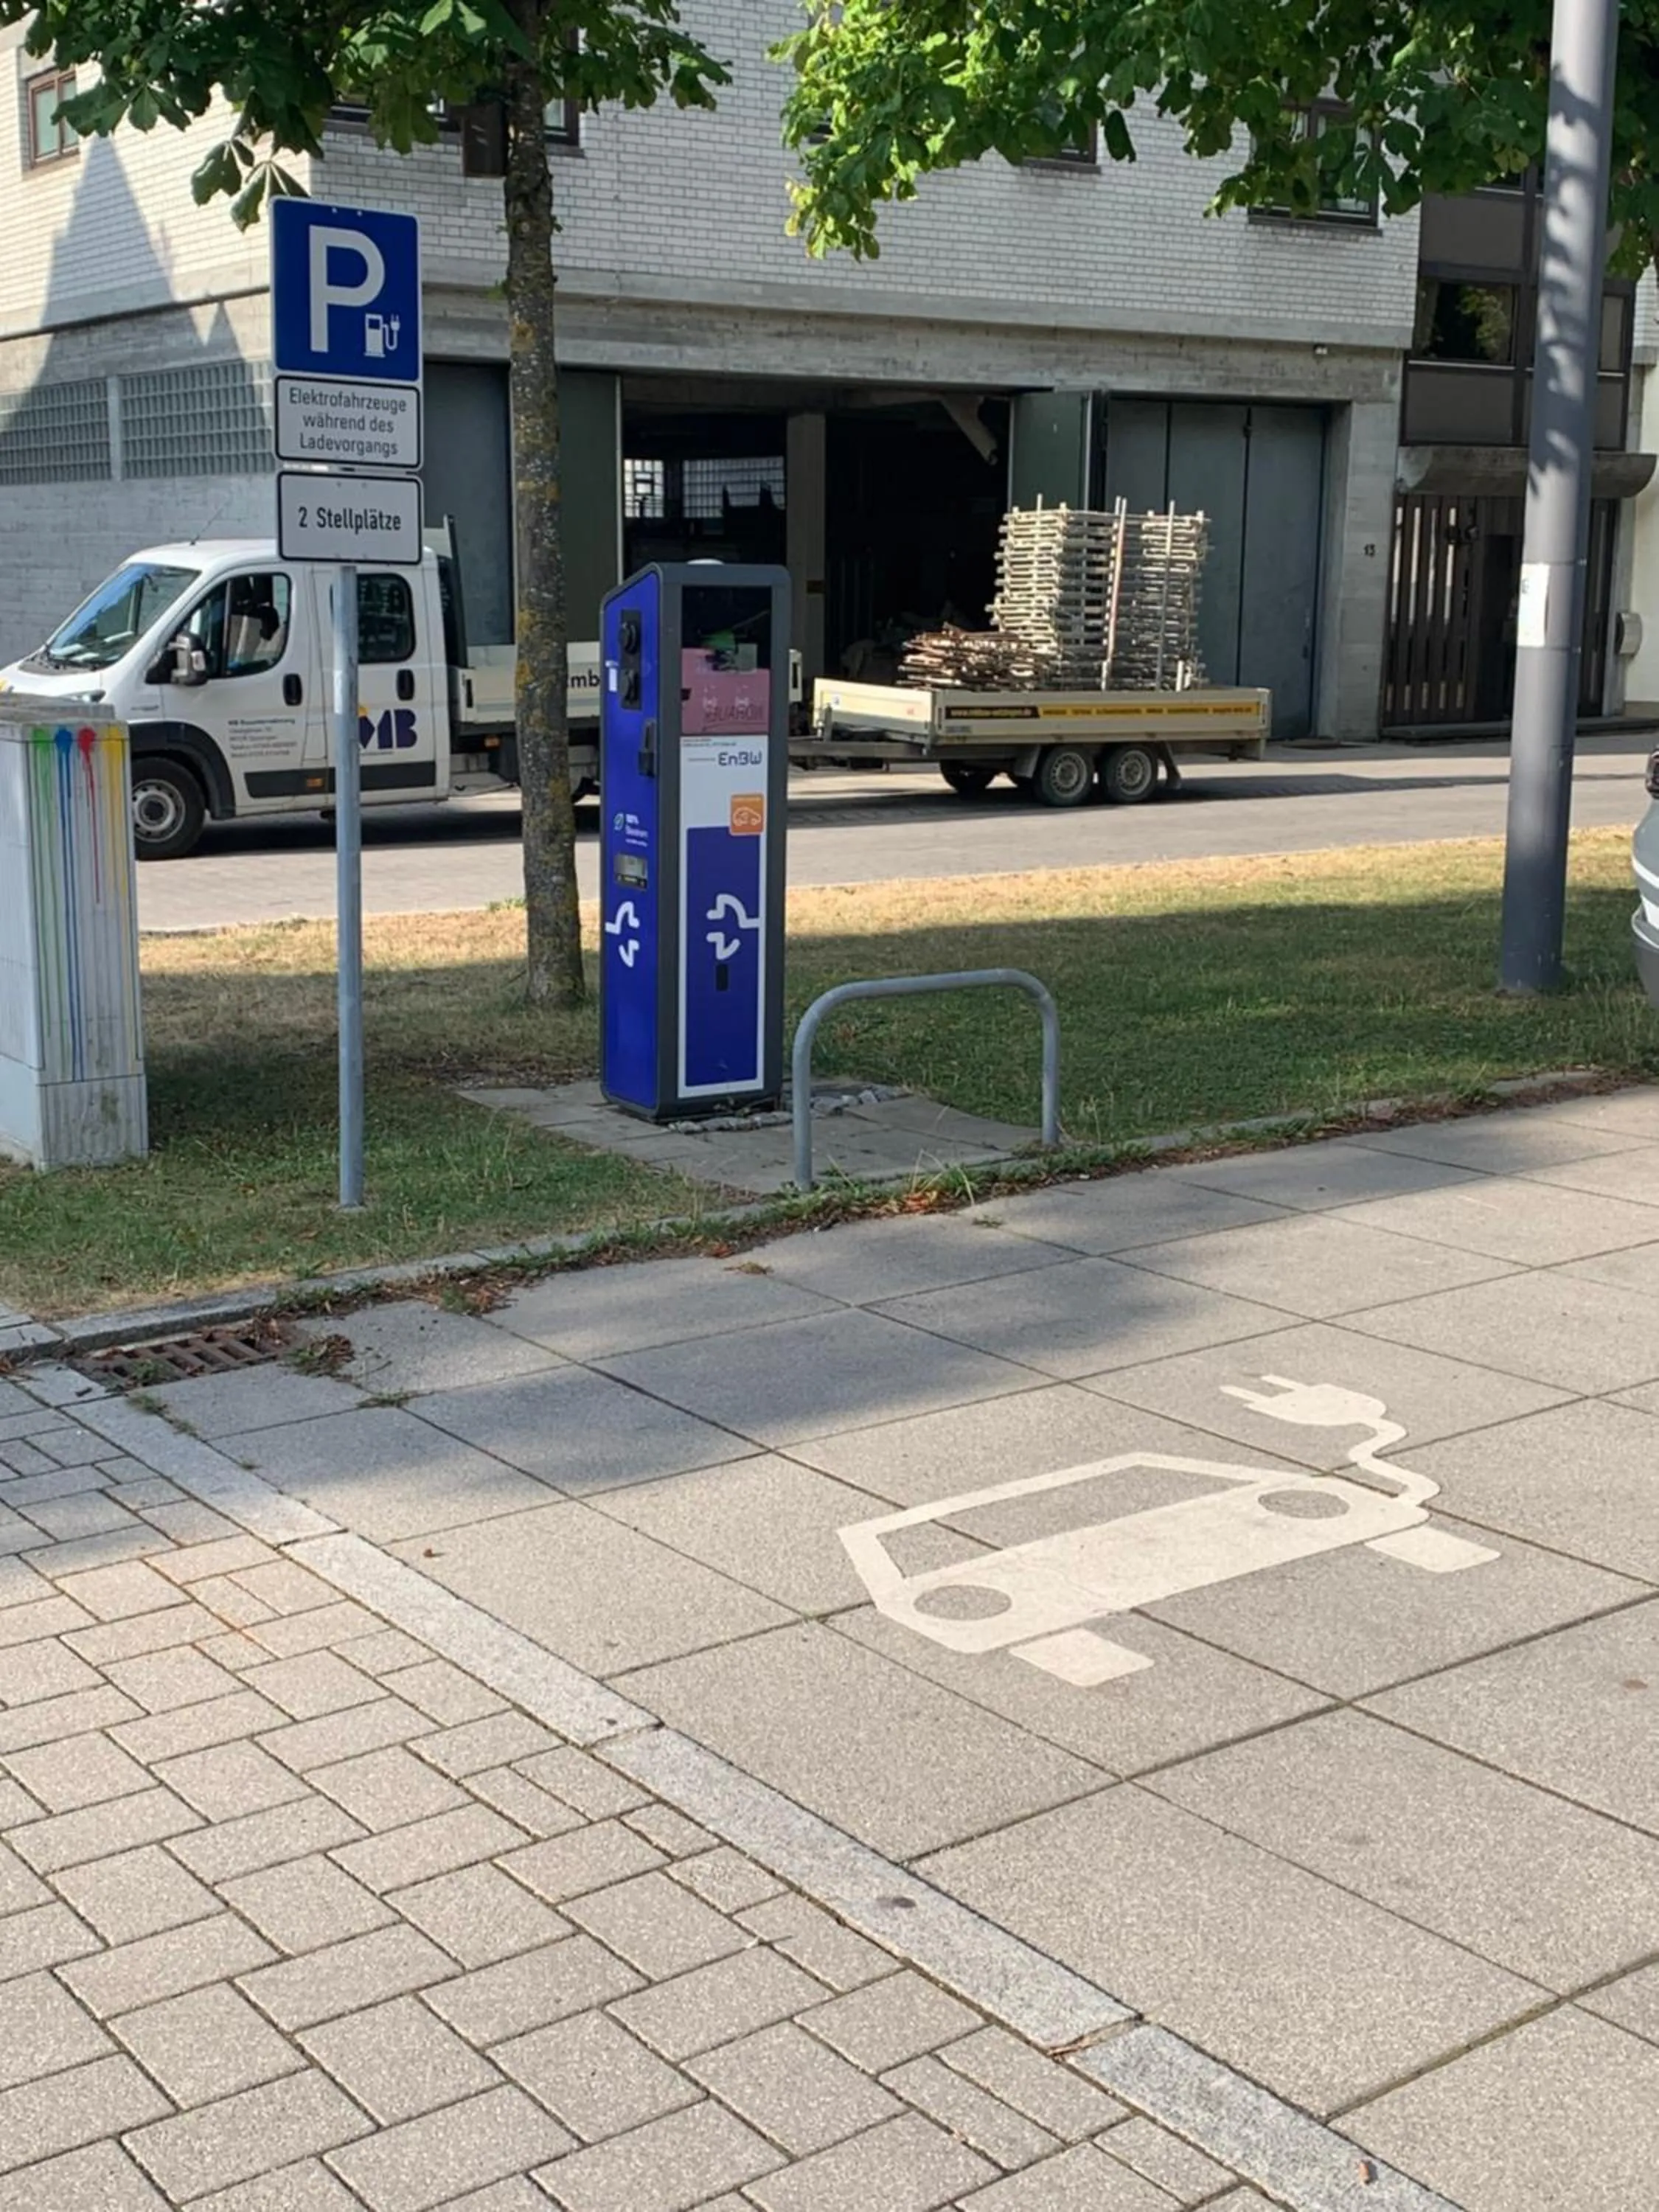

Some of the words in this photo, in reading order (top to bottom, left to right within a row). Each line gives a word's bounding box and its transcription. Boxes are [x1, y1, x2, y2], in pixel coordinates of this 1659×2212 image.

[309, 224, 386, 353] P
[289, 386, 407, 415] Elektrofahrzeuge
[302, 411, 366, 431] während
[369, 416, 394, 433] des
[299, 432, 399, 459] Ladevorgangs
[298, 506, 308, 528] 2
[316, 507, 402, 535] Stellplätze
[718, 751, 762, 767] EnBW
